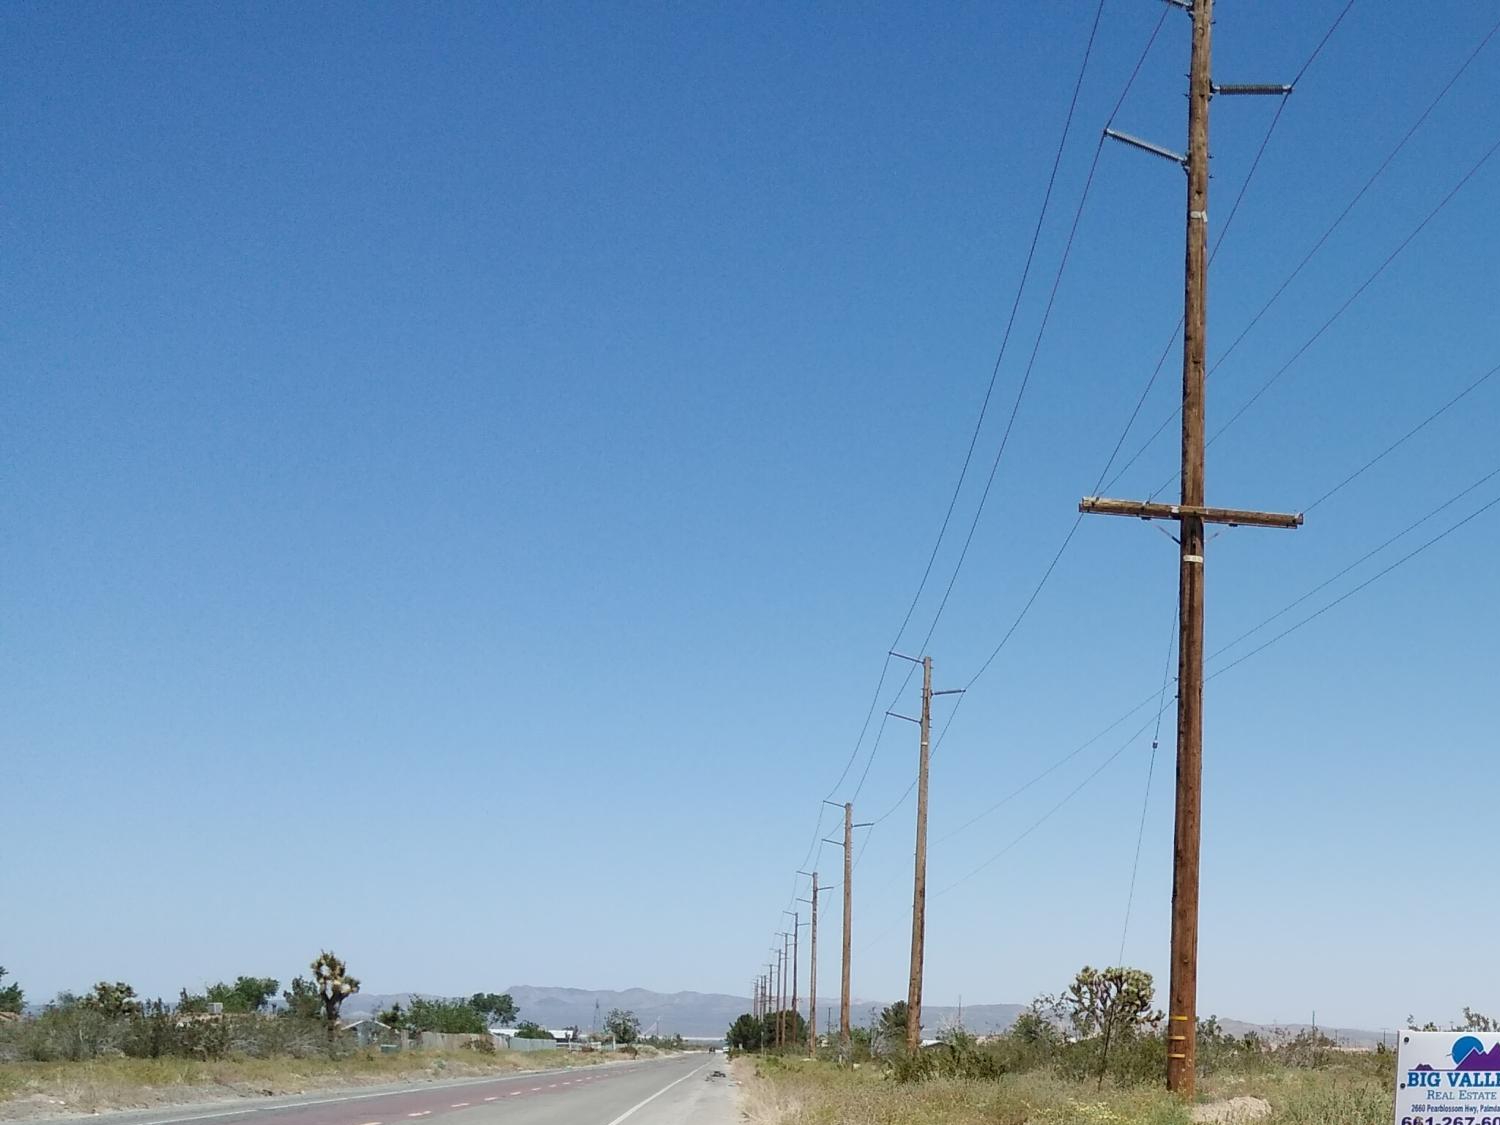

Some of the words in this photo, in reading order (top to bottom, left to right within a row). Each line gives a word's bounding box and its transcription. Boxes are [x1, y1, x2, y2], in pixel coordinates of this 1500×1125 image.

[1407, 1072, 1441, 1087] BIG
[1427, 1090, 1455, 1100] REAL
[1459, 1090, 1497, 1100] ESTATE
[1427, 1104, 1464, 1113] Pearblossom
[1465, 1104, 1479, 1114] Hwy,
